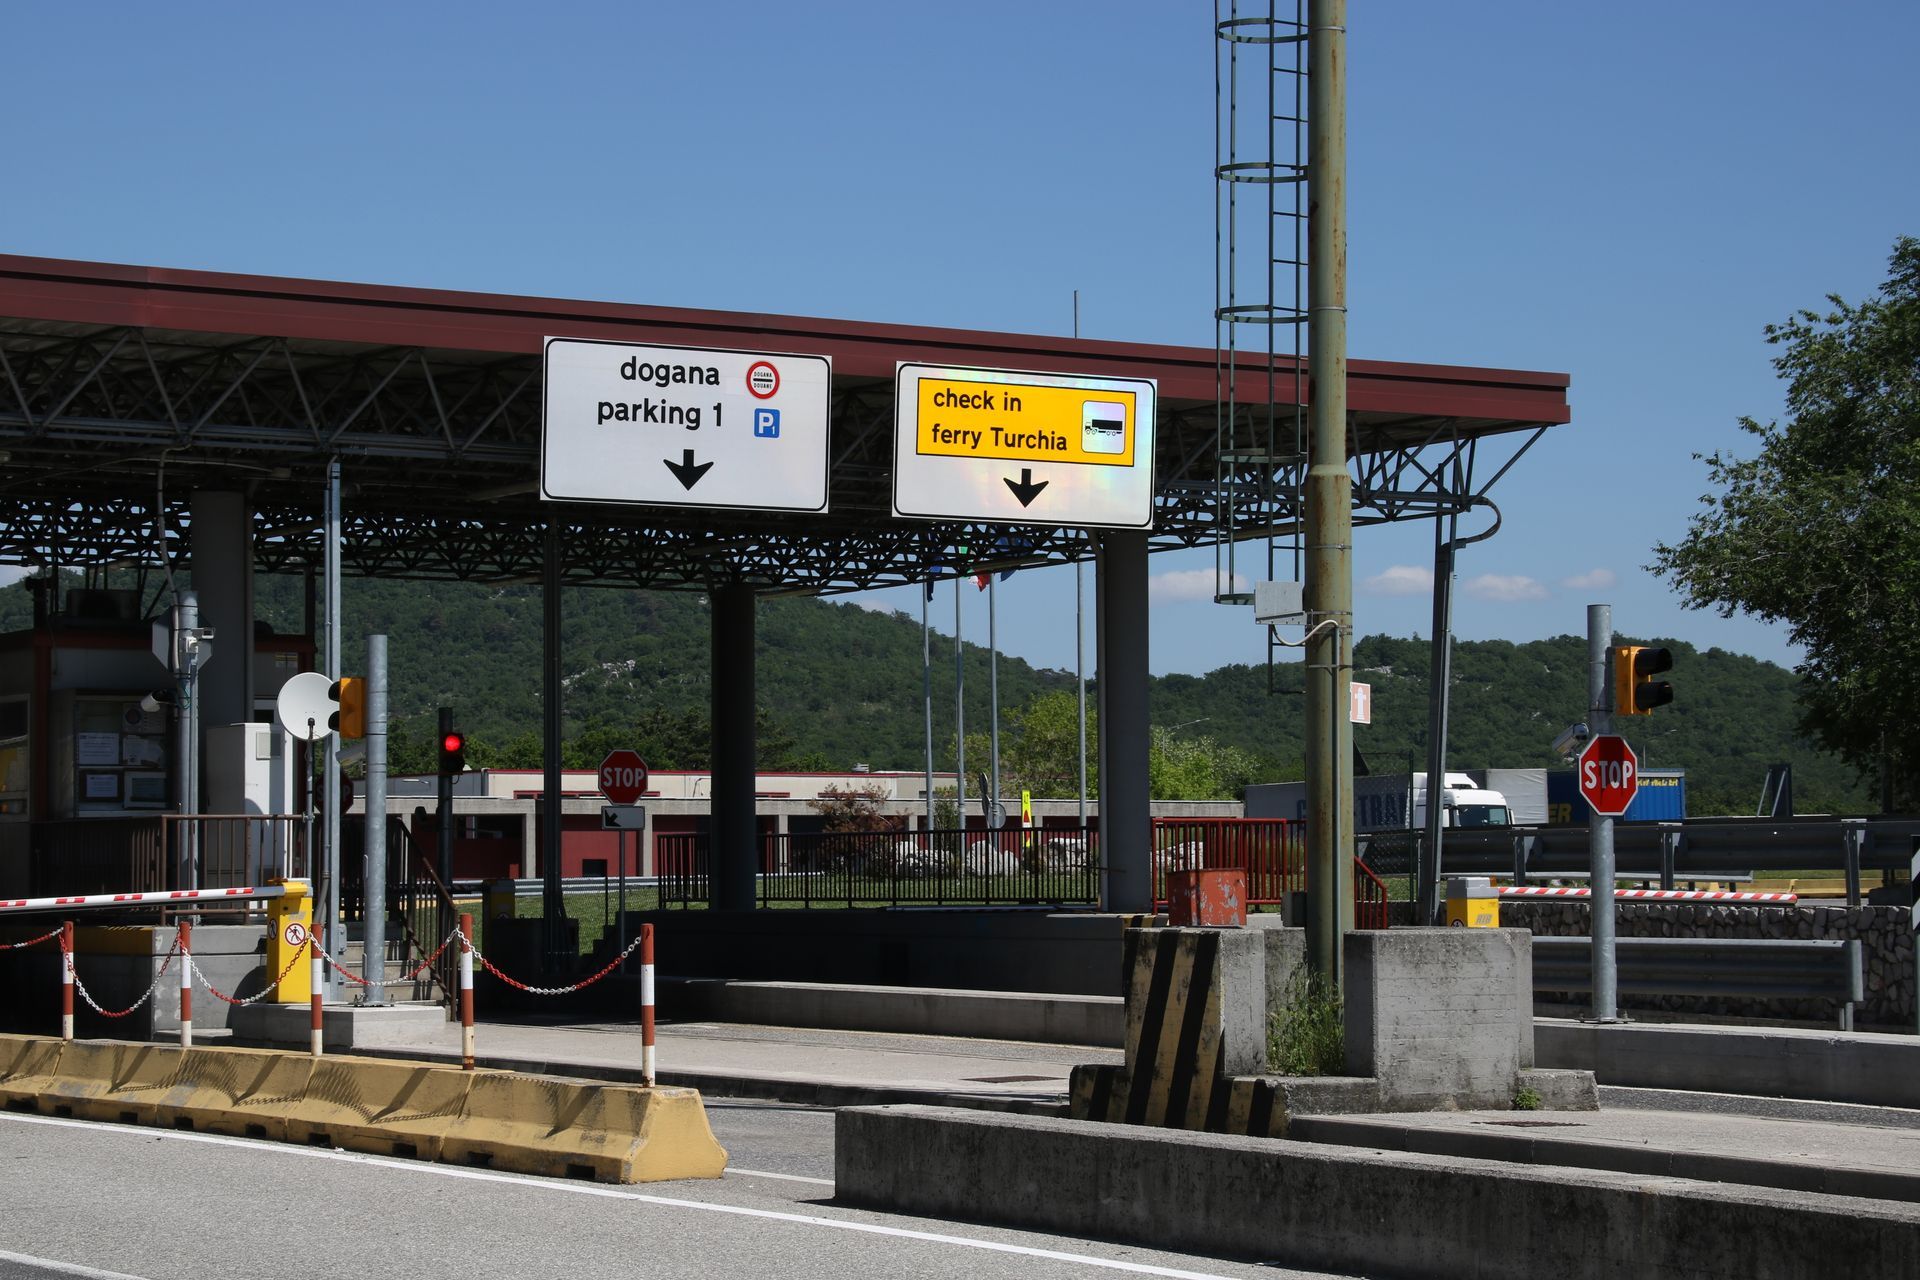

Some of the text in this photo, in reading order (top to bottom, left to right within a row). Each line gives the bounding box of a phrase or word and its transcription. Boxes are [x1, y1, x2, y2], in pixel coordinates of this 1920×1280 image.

[620, 355, 720, 388] dogana
[598, 398, 722, 430] parking 1
[933, 388, 1022, 412] check in
[932, 423, 1067, 451] ferry Turchia
[603, 767, 645, 788] STOP
[1584, 760, 1634, 789] STOP
